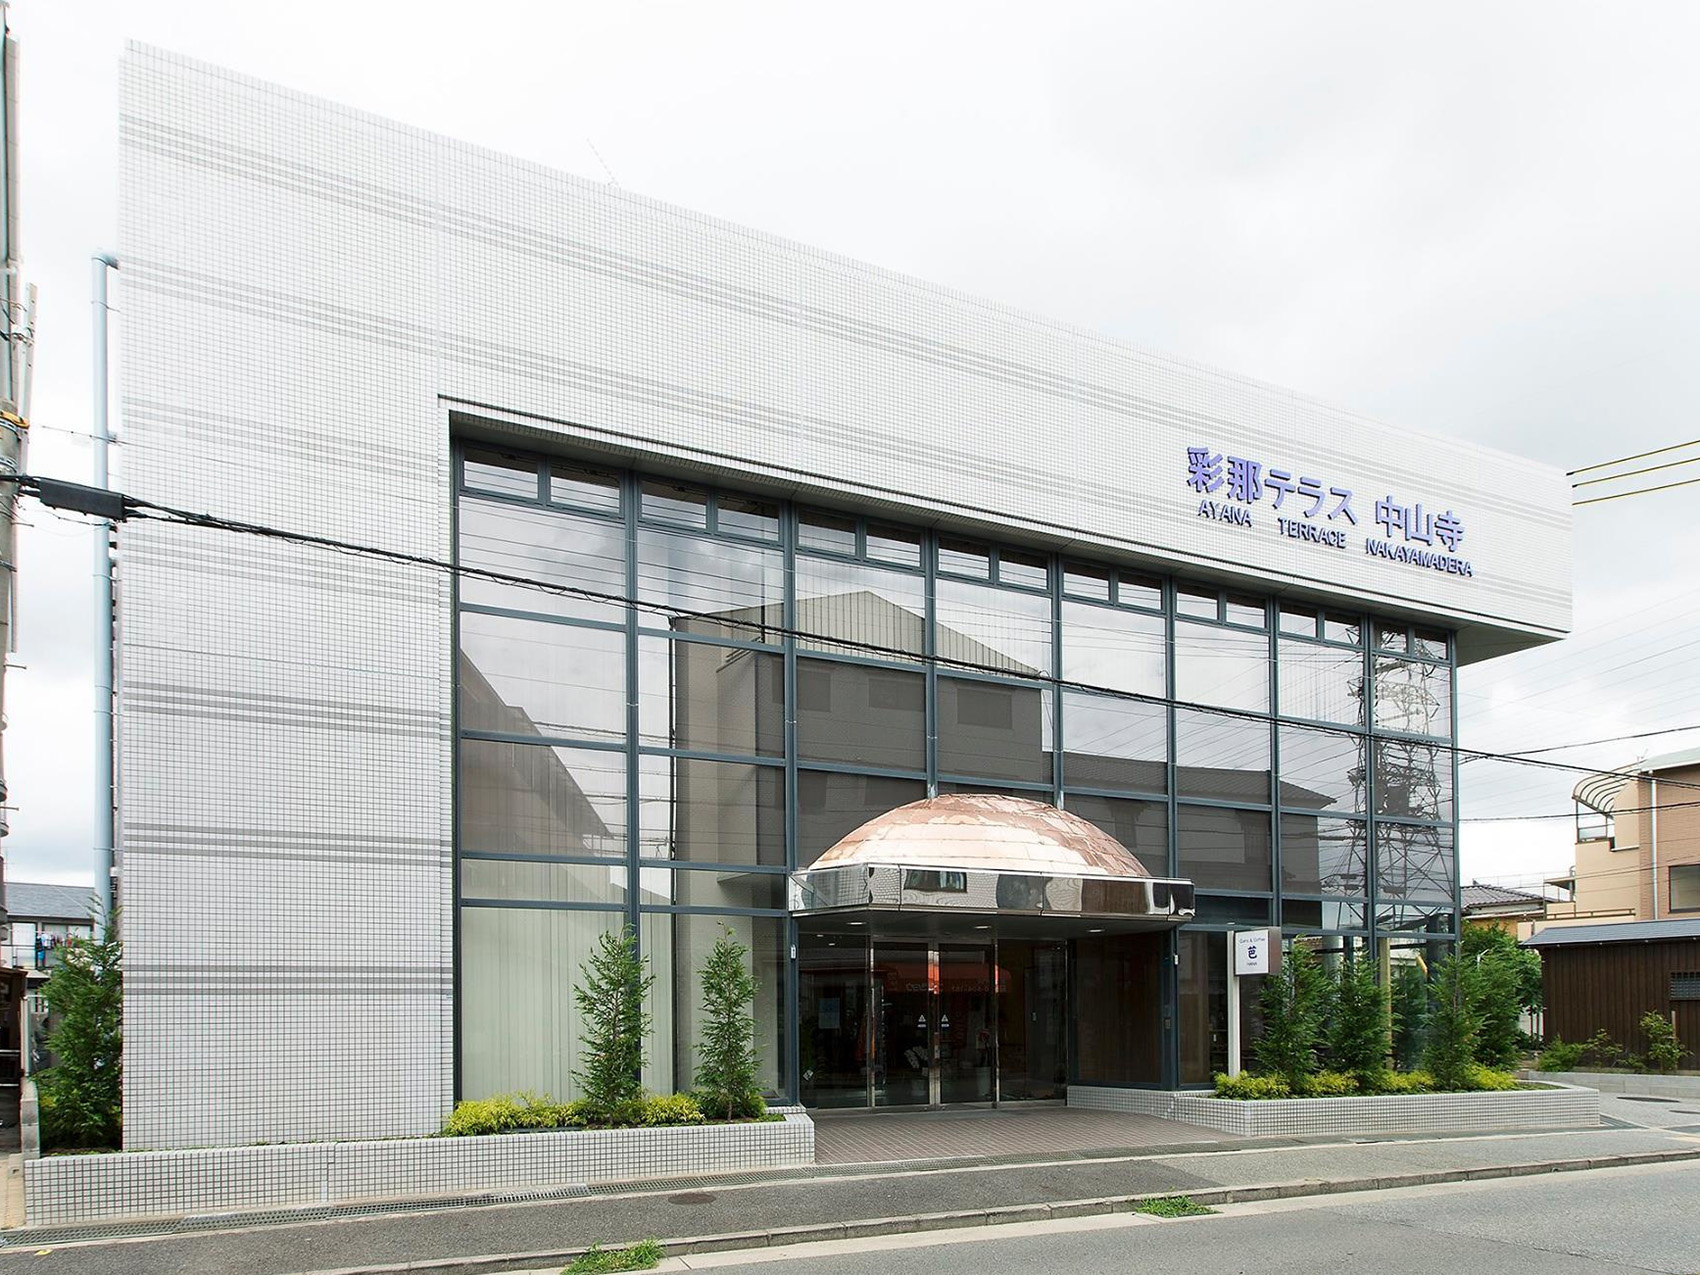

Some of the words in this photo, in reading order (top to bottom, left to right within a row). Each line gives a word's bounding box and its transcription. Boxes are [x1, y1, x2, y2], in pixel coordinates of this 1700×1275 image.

[1187, 447, 1358, 525] 彩那テラス
[1375, 495, 1465, 552] 中山寺
[1198, 500, 1252, 527] AYANA
[1277, 517, 1346, 549] TERRACE
[1365, 538, 1473, 577] NAKAYAMADERA
